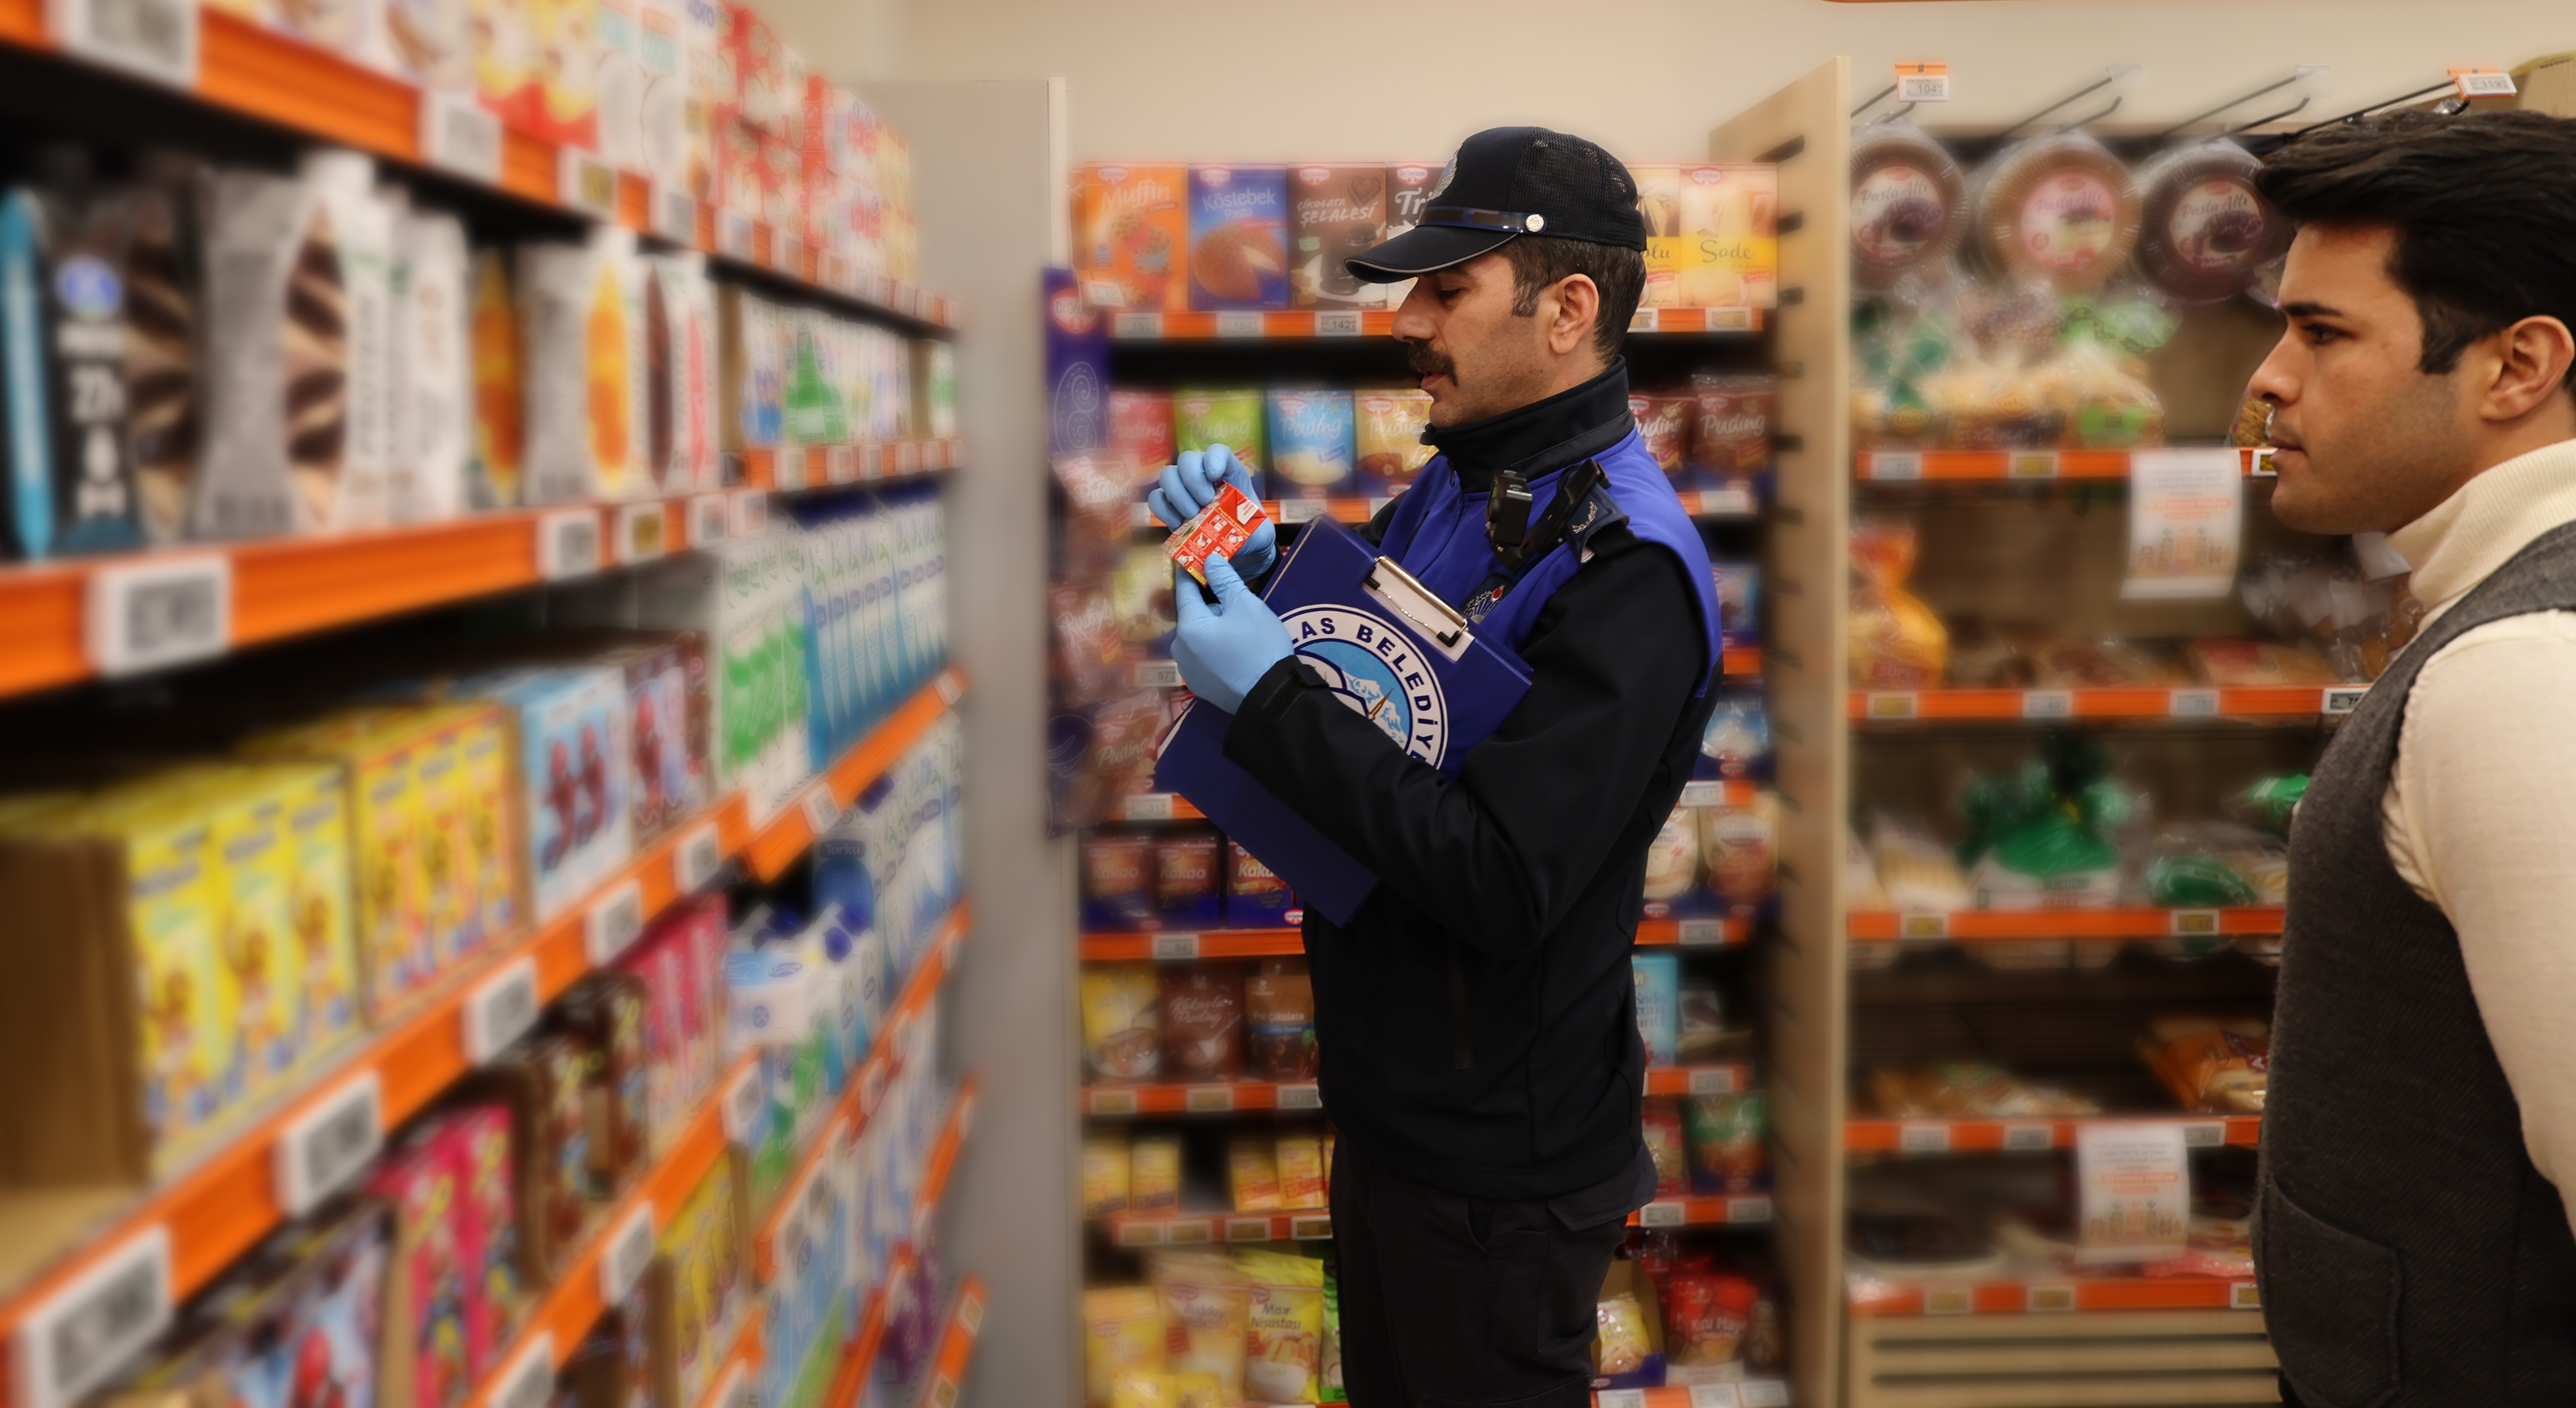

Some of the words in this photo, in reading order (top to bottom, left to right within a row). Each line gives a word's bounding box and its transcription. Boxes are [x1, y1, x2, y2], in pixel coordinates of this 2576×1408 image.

[1917, 84, 1937, 93] 104
[1100, 179, 1172, 213] Muffin
[1202, 188, 1277, 212] Köstebek
[1860, 185, 1901, 205] Pasta
[1297, 197, 1346, 212] ÇİKOLATA
[2035, 194, 2073, 214] Pasta
[2181, 199, 2219, 219] Pasta
[1224, 207, 1253, 220] Pasta
[1300, 201, 1379, 229] ŞELALESİ
[1700, 239, 1756, 263] Sade
[1133, 322, 1151, 331] 153
[1332, 320, 1350, 330] 142
[1279, 415, 1343, 440] Puding
[1699, 412, 1766, 438] Puding
[1896, 416, 1923, 424] UNO
[1109, 418, 1166, 444] Puding
[1184, 417, 1251, 443] Puding
[1878, 664, 1922, 678] SÜPER
[1097, 737, 1149, 769] Puding
[824, 844, 860, 854] Torku
[1093, 864, 1139, 879] Kakao
[1160, 865, 1206, 879] Kakao
[1184, 1303, 1225, 1317] Buğday
[1261, 1304, 1291, 1315] Mısır
[1251, 1318, 1302, 1331] Nişastası
